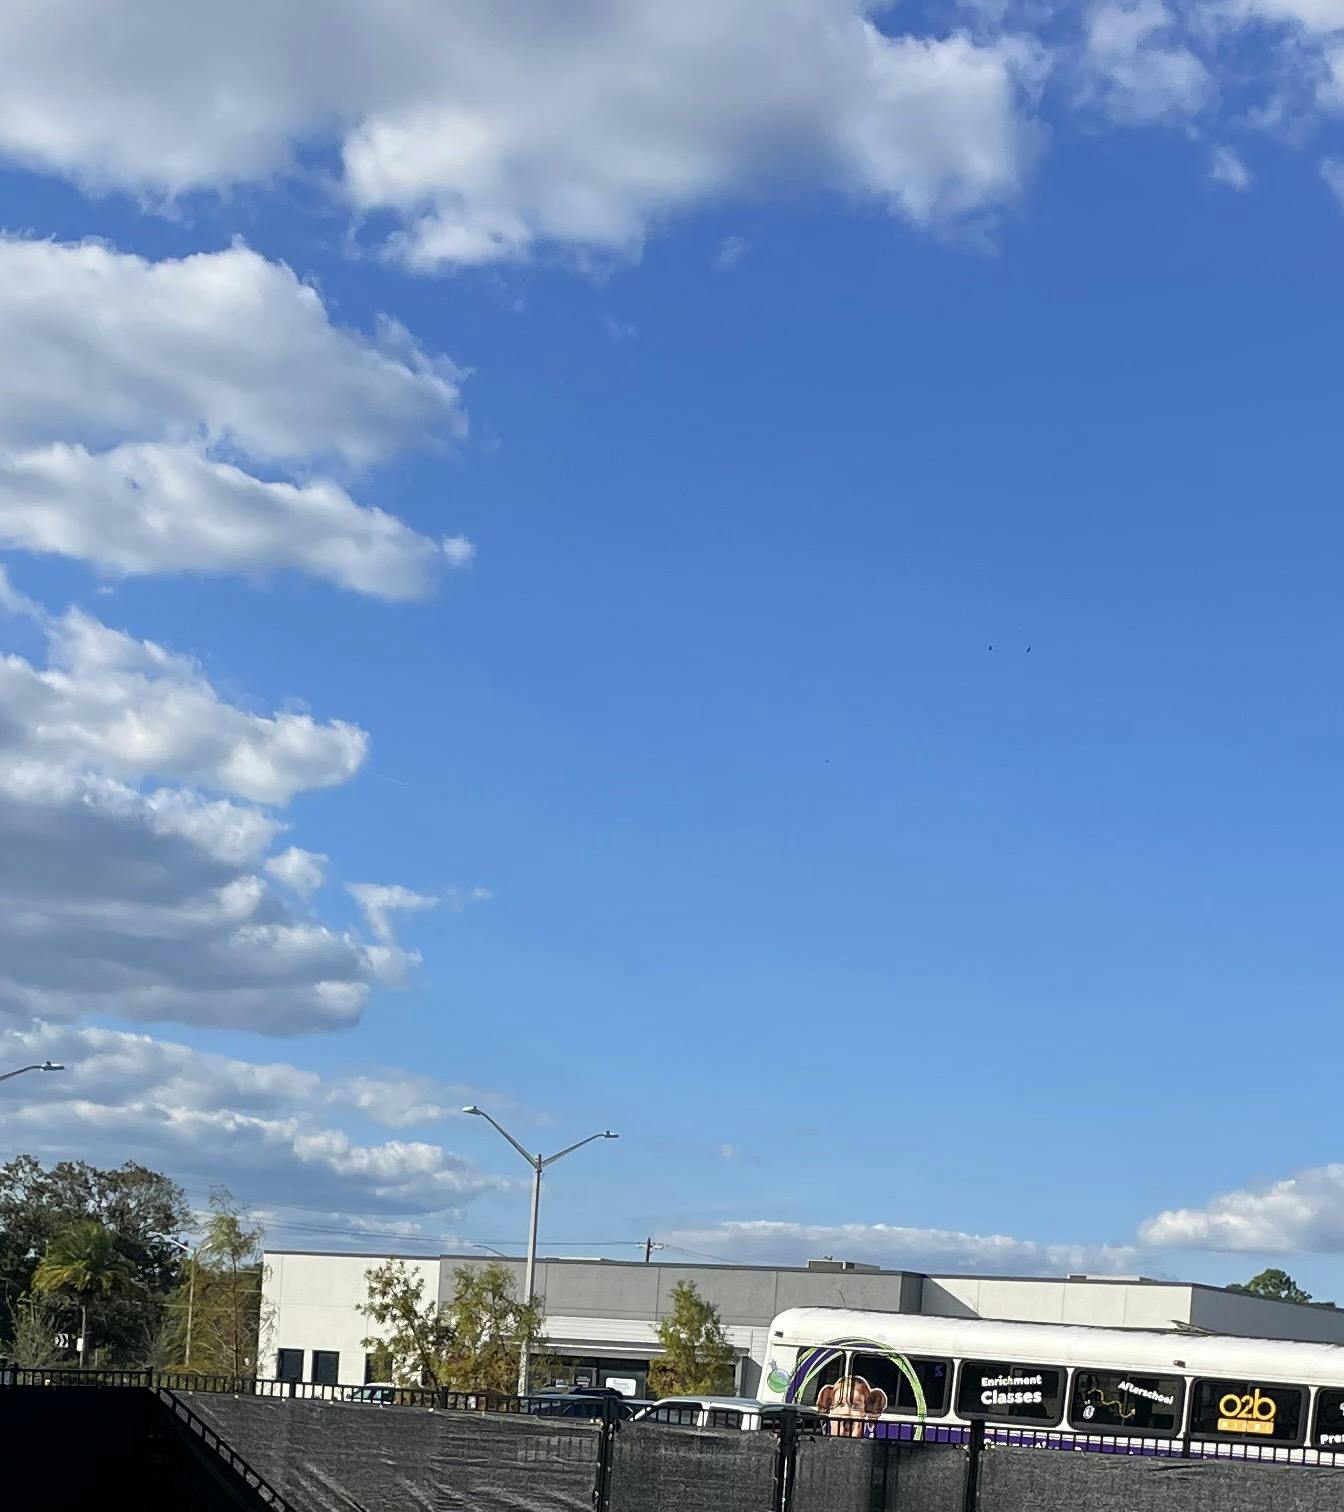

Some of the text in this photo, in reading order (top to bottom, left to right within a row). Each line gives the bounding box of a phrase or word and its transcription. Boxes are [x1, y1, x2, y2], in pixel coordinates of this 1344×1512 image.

[981, 1374, 1043, 1388] Enrichment
[981, 1389, 1043, 1406] Classes
[1117, 1380, 1174, 1406] Afterschool
